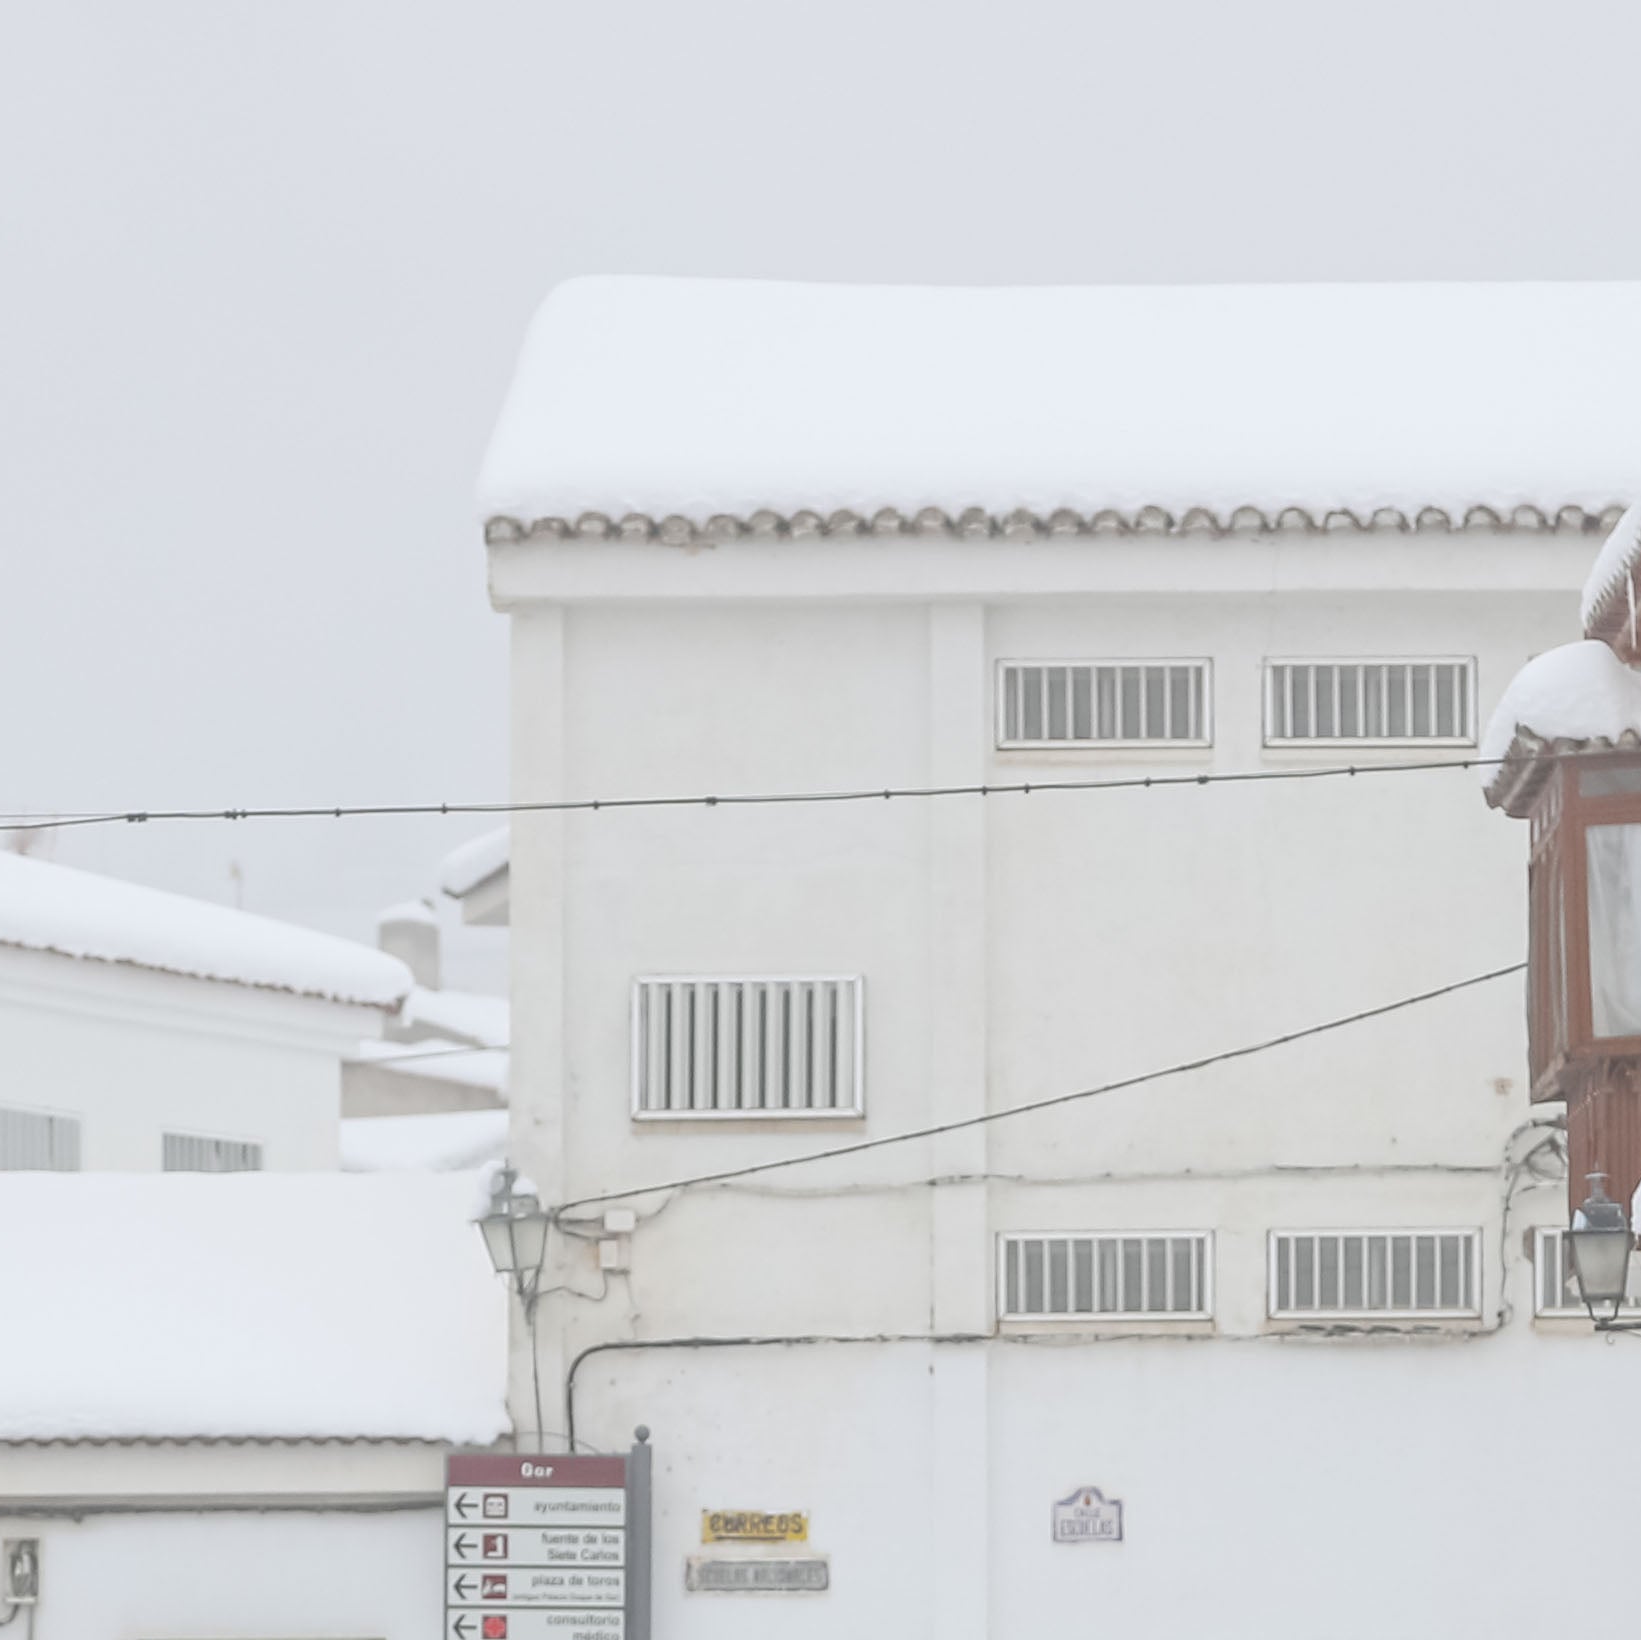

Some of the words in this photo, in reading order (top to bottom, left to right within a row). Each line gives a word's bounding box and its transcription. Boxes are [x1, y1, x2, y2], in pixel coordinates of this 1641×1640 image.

[534, 1501, 621, 1513] ayuntamiento
[709, 1513, 803, 1534] CORREOS
[541, 1532, 578, 1544] fuente
[583, 1532, 597, 1544] de
[531, 1575, 564, 1587] plaza
[568, 1575, 583, 1586] de
[587, 1575, 620, 1586] toros
[546, 1614, 620, 1625] consultorio
